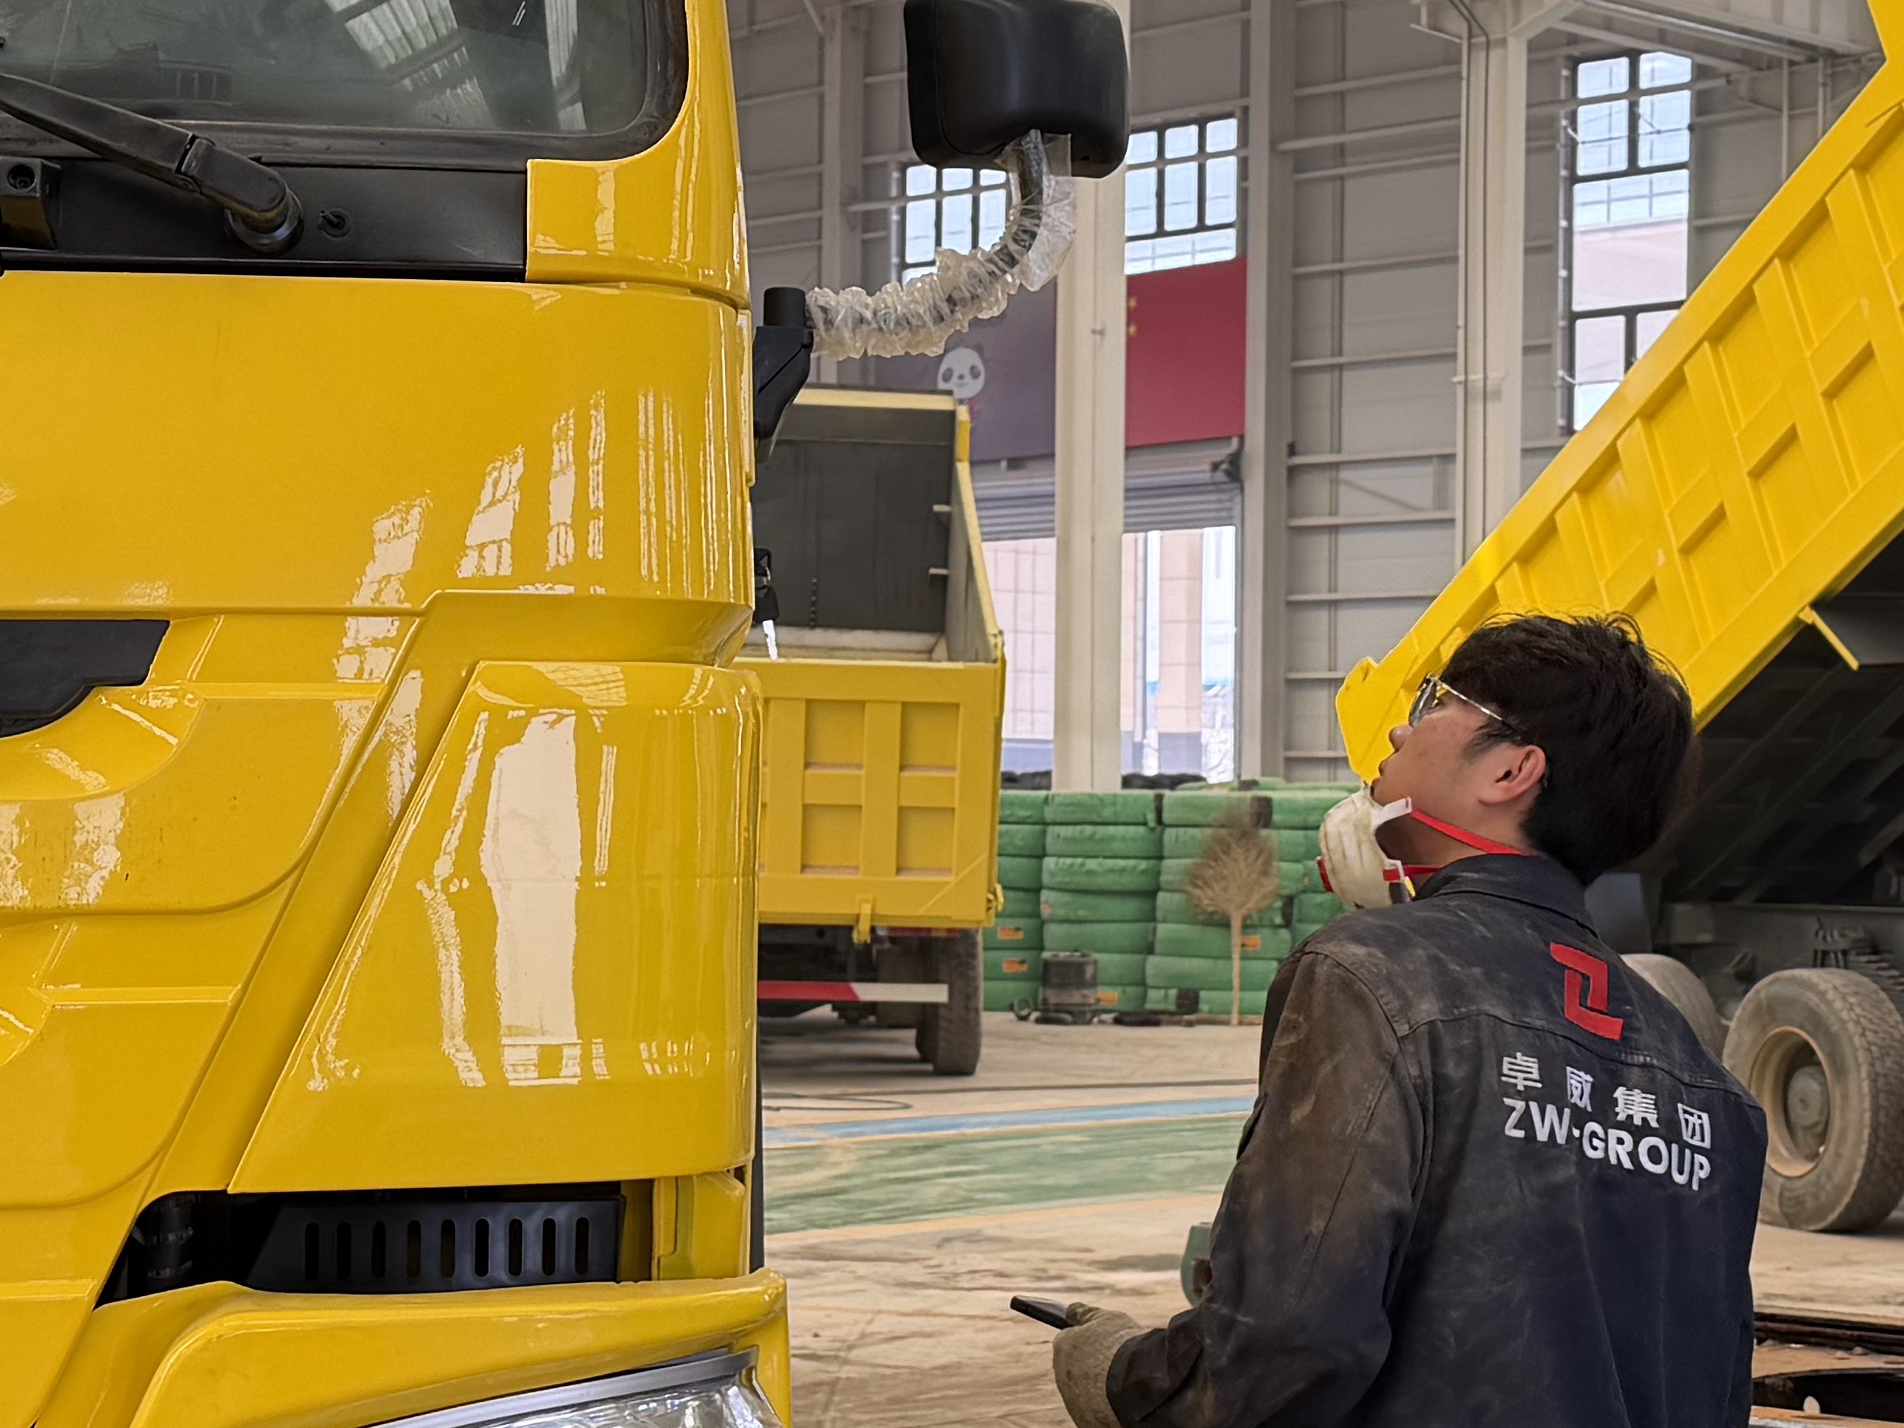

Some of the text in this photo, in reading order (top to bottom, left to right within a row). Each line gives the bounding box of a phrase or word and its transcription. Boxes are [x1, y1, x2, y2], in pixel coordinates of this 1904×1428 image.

[1500, 1051, 1712, 1150] 卓威集团
[1502, 1097, 1711, 1191] ZW-GROUP
